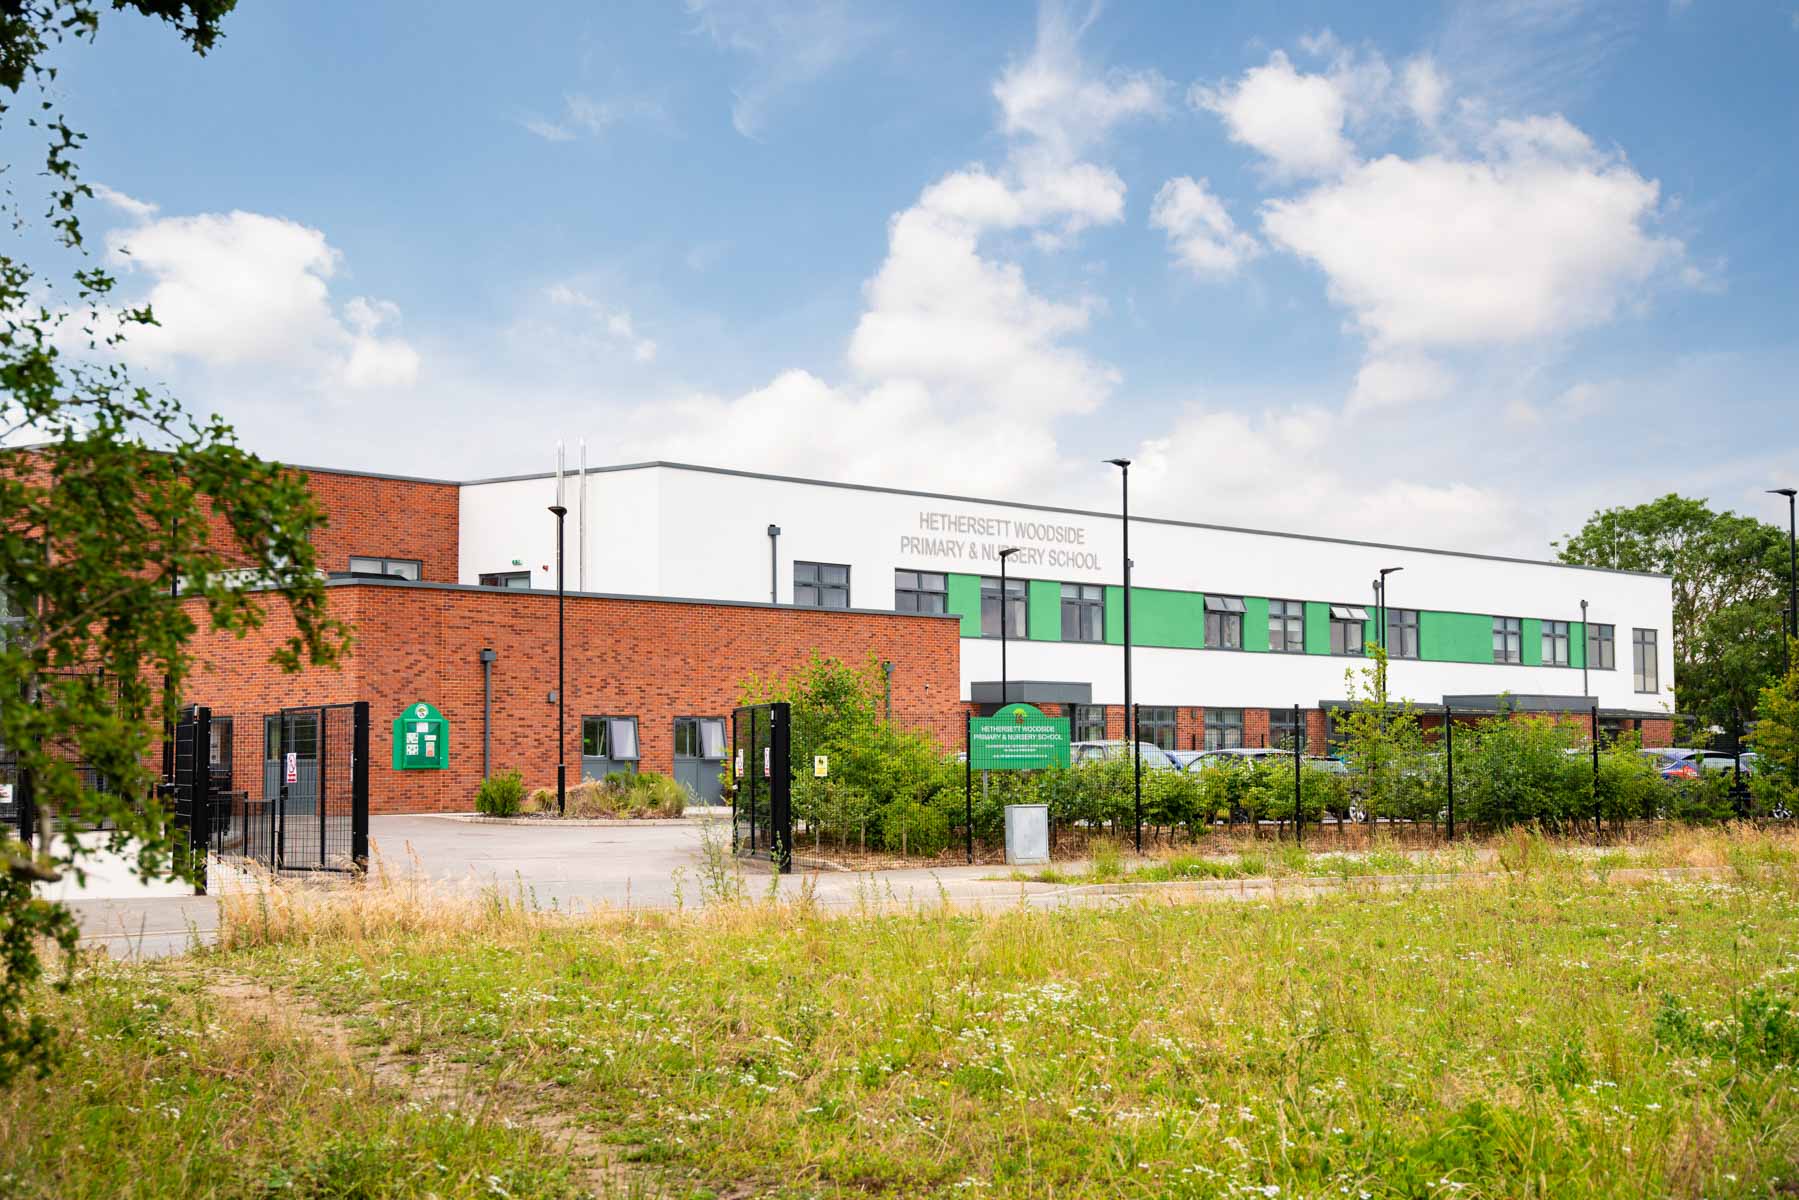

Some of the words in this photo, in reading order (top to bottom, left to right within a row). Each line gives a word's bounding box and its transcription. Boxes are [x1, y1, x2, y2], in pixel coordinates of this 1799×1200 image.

[919, 511, 1011, 537] HETHERSETT
[1014, 522, 1085, 545] WOODSIDE
[900, 535, 965, 559] PRIMARY
[968, 542, 979, 560] &
[1048, 549, 1101, 571] SCHOOL
